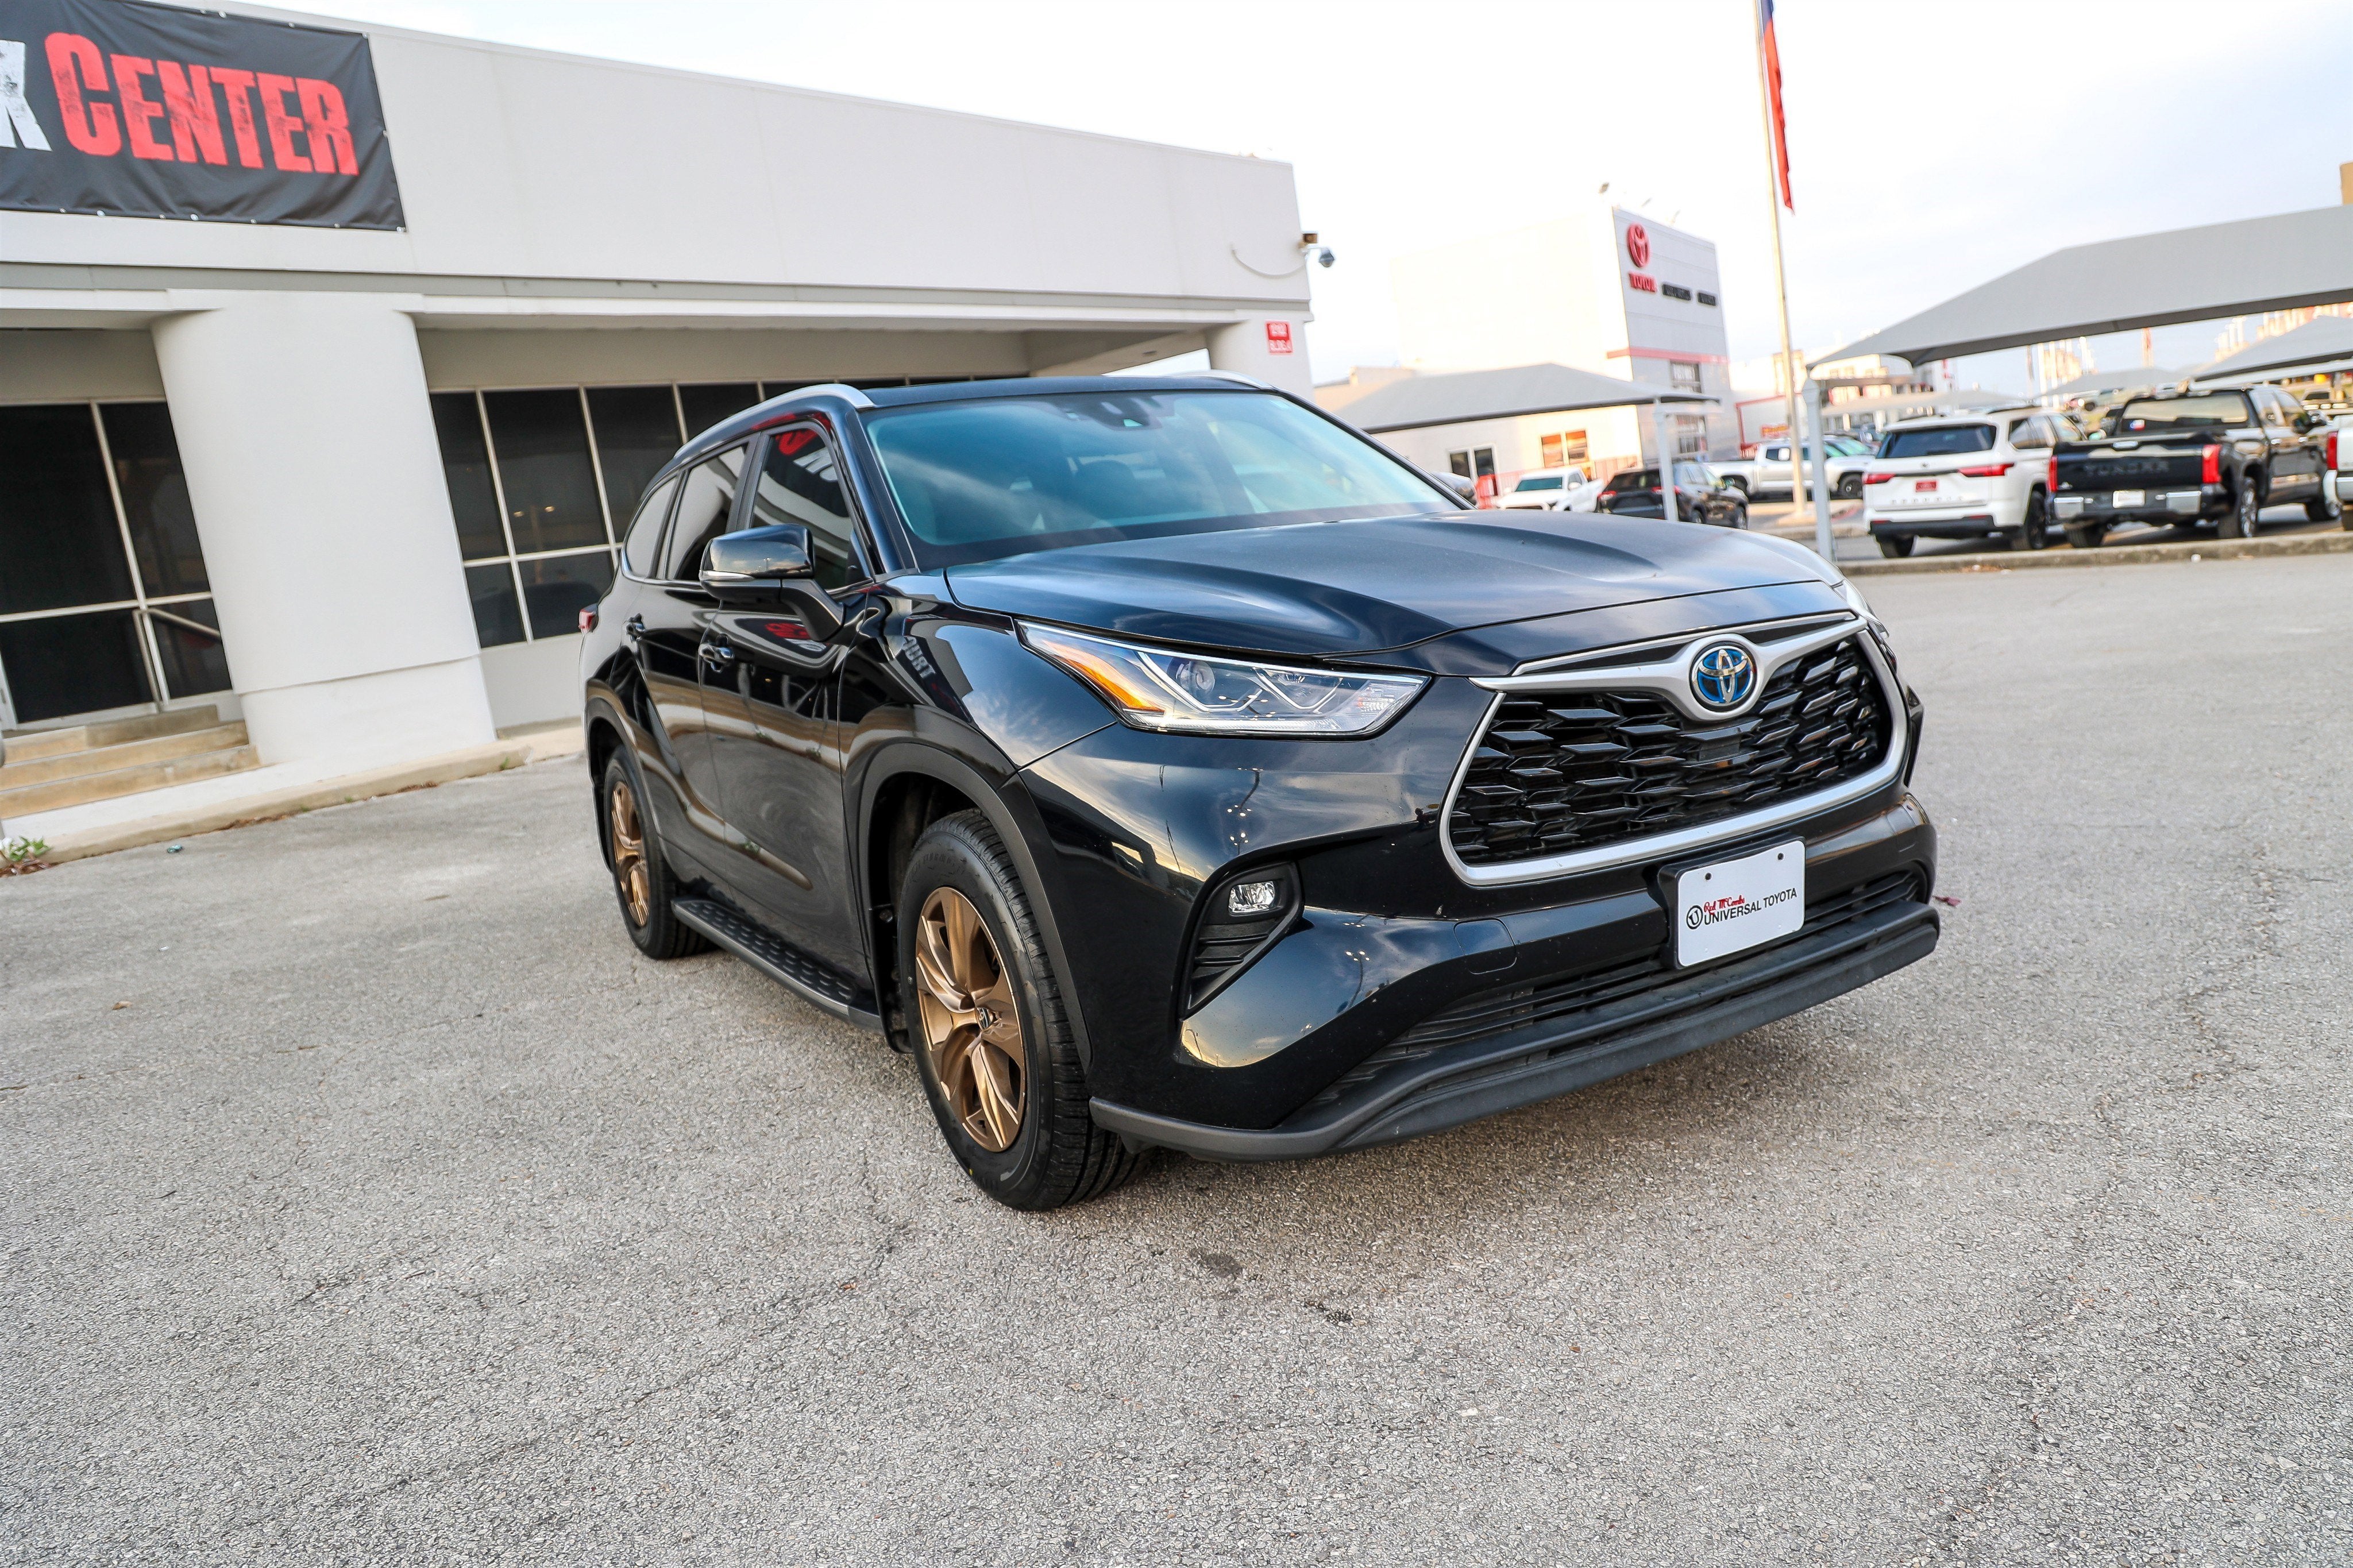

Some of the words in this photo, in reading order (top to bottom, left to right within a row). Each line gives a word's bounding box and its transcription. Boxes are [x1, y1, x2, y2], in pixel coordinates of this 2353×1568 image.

[44, 32, 359, 175] CENTER
[1704, 901, 1762, 925] UNIVERSAL
[1763, 887, 1797, 909] TOYOTA
[1704, 901, 1717, 915] Red
